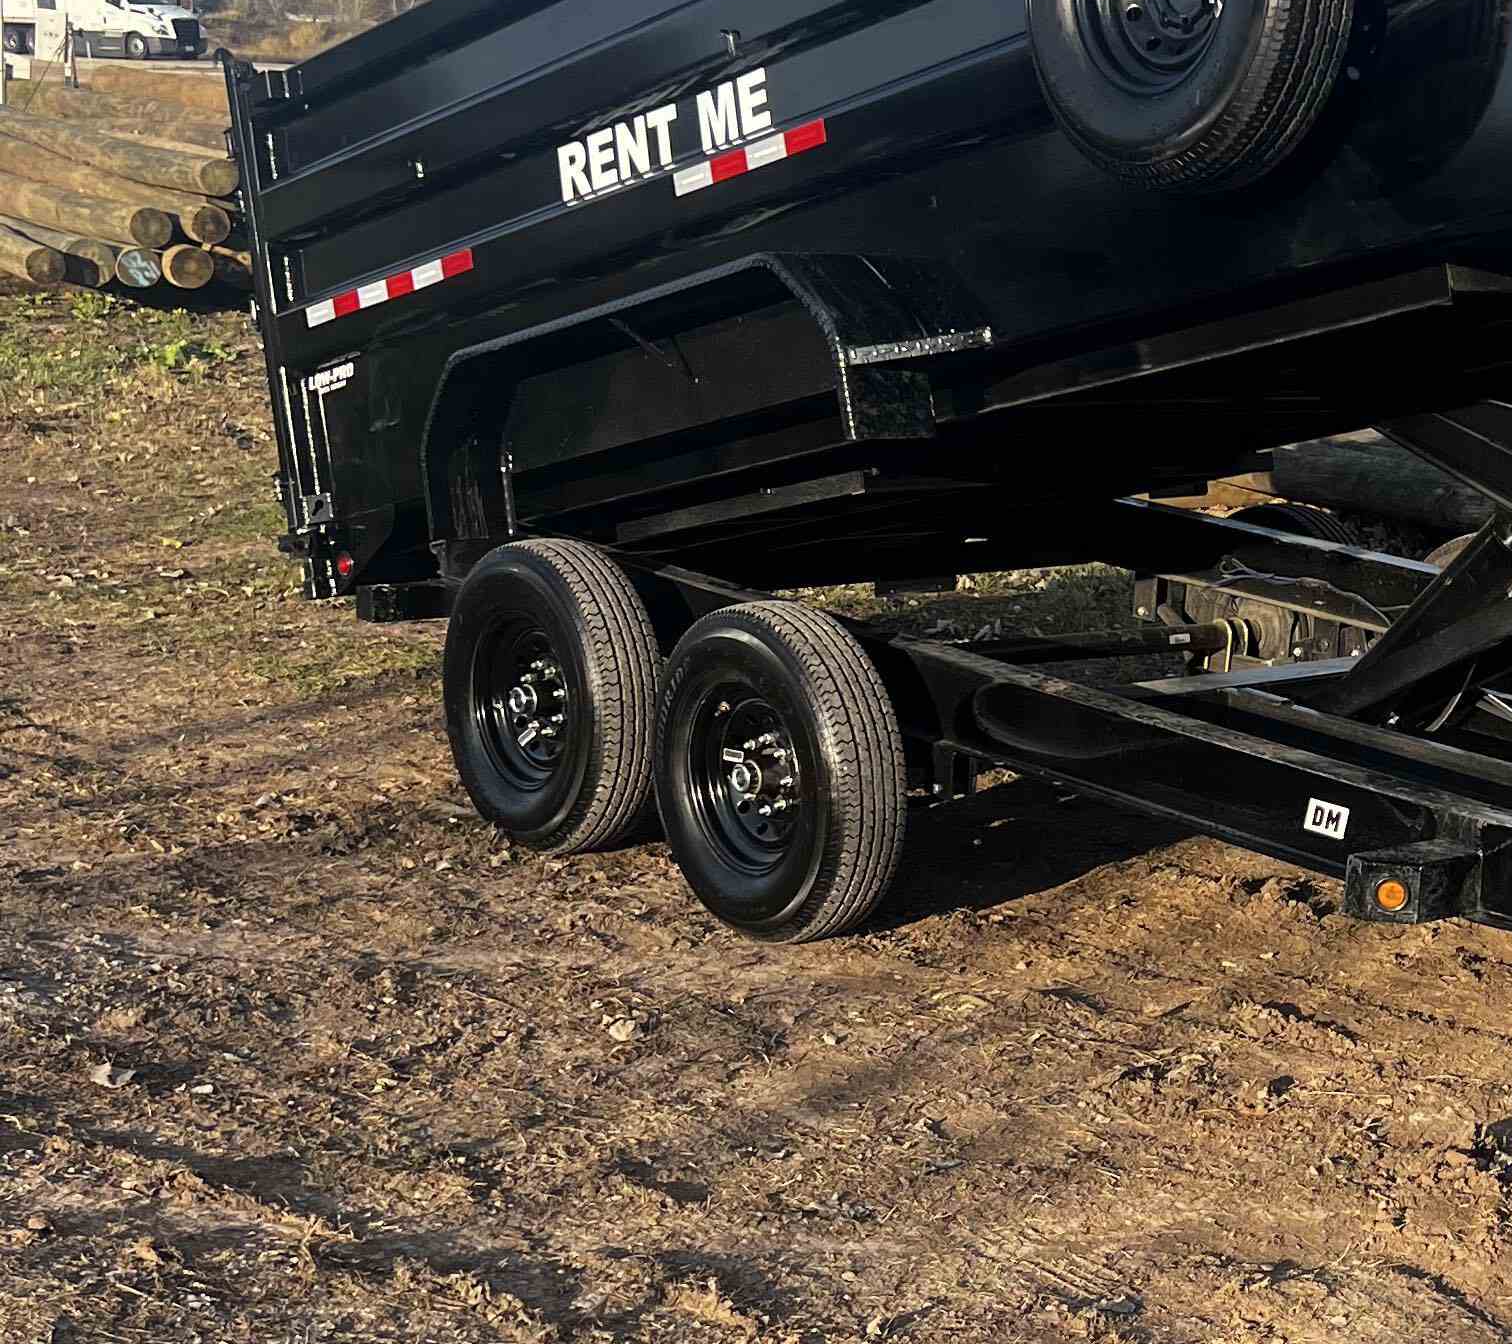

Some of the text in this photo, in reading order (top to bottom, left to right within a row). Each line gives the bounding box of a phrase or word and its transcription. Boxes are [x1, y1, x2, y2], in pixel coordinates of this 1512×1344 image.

[557, 67, 772, 203] RENT ME
[1311, 804, 1342, 833] DM
